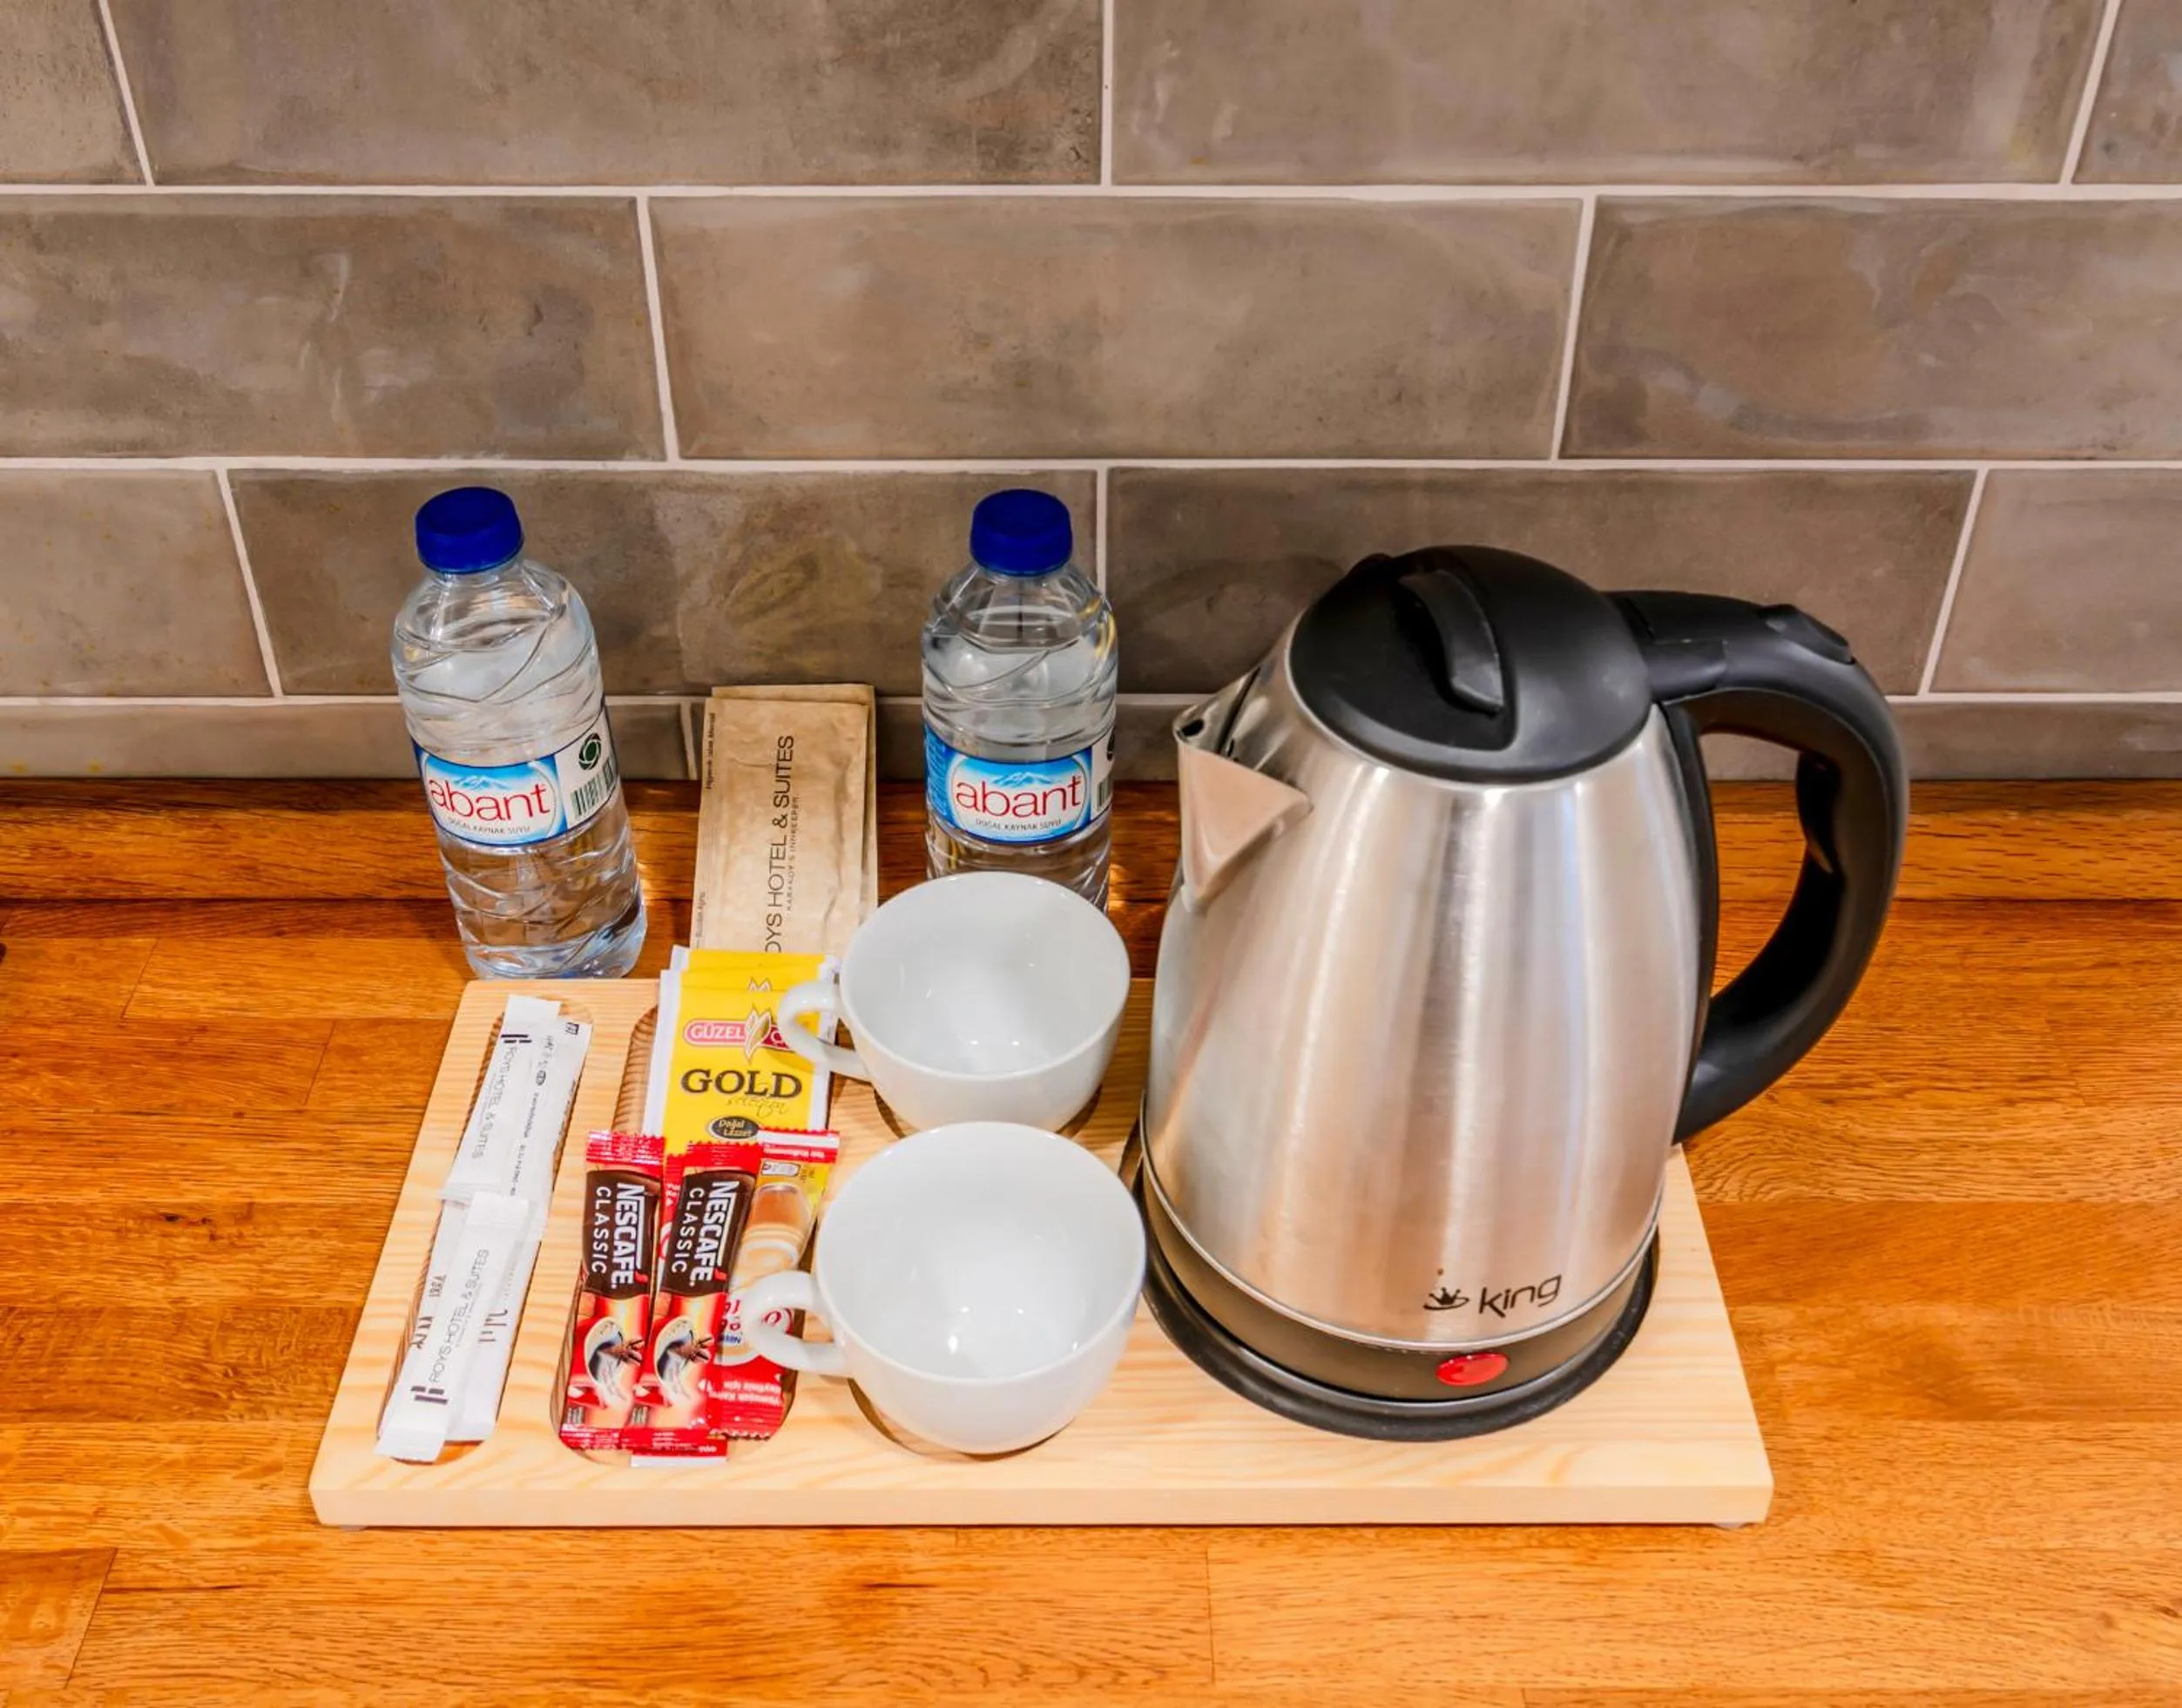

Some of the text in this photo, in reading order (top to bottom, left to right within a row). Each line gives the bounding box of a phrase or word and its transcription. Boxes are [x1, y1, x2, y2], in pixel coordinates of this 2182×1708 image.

[428, 778, 551, 822] abant
[773, 735, 794, 810] SUITES
[956, 774, 1081, 819] abant
[772, 813, 788, 828] &
[767, 835, 787, 908] HOTEL
[680, 1068, 803, 1099] GOLD
[591, 1185, 611, 1274] CLASSIC
[671, 1187, 703, 1273] CLASSIC
[446, 1305, 470, 1344] HOTEL
[464, 1248, 490, 1291] SUITES
[1478, 1274, 1562, 1318] king
